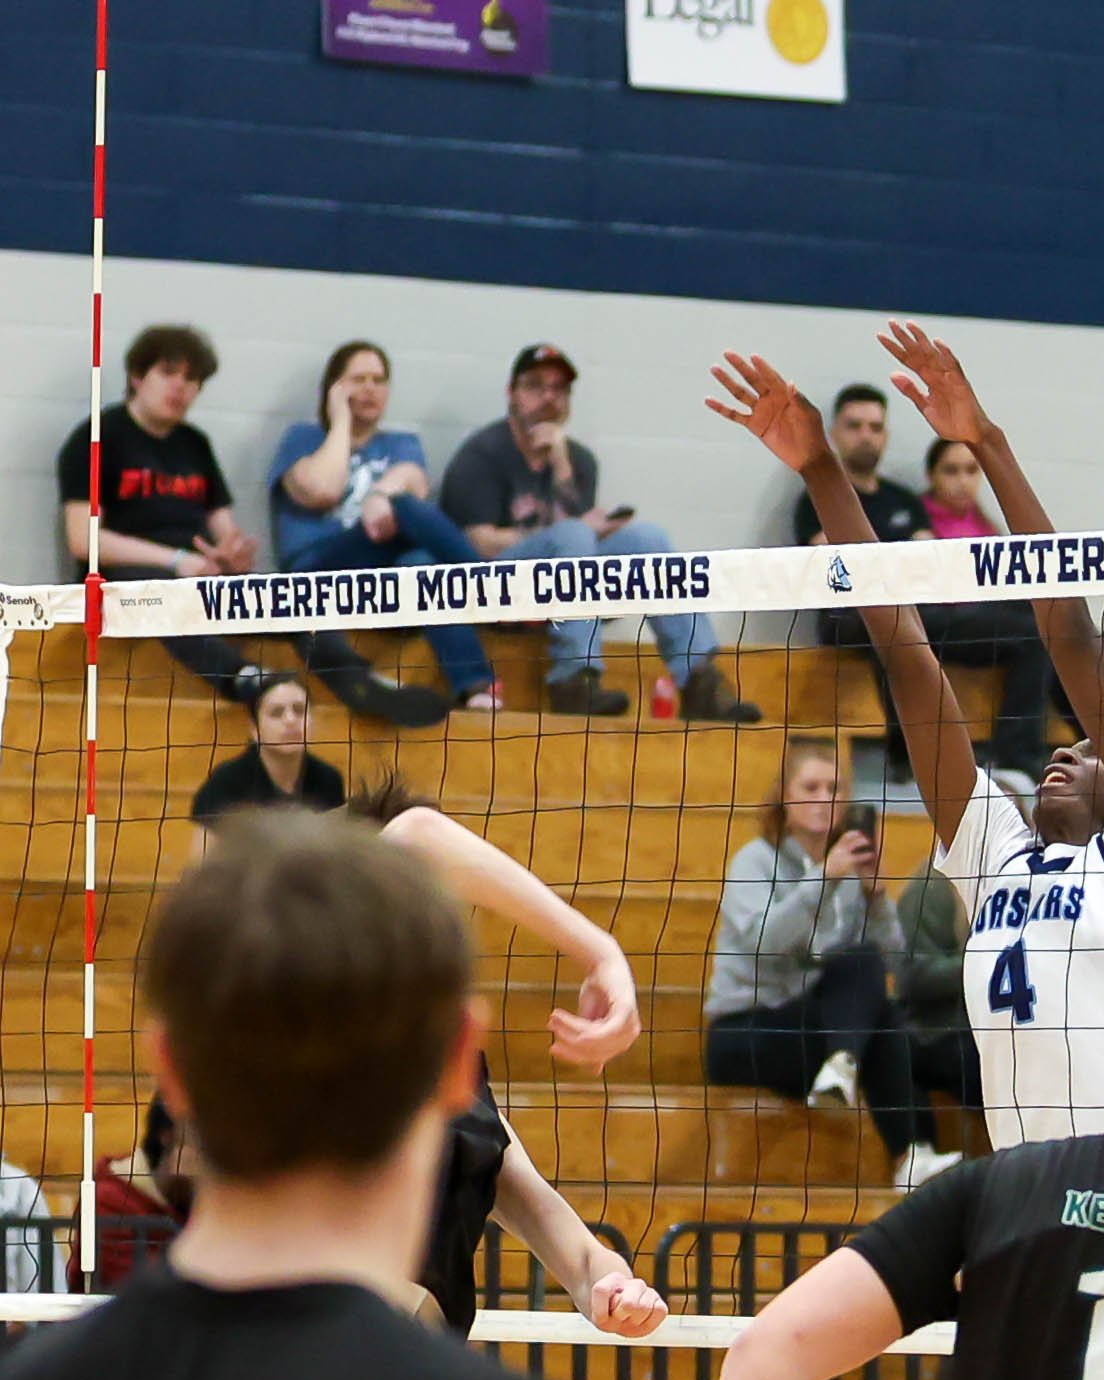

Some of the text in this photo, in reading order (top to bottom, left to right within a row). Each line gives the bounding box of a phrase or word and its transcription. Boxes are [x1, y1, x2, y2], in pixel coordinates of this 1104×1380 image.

[196, 556, 710, 621] WATERFORD MOTT CORSAIRS
[987, 936, 1038, 1025] 4
